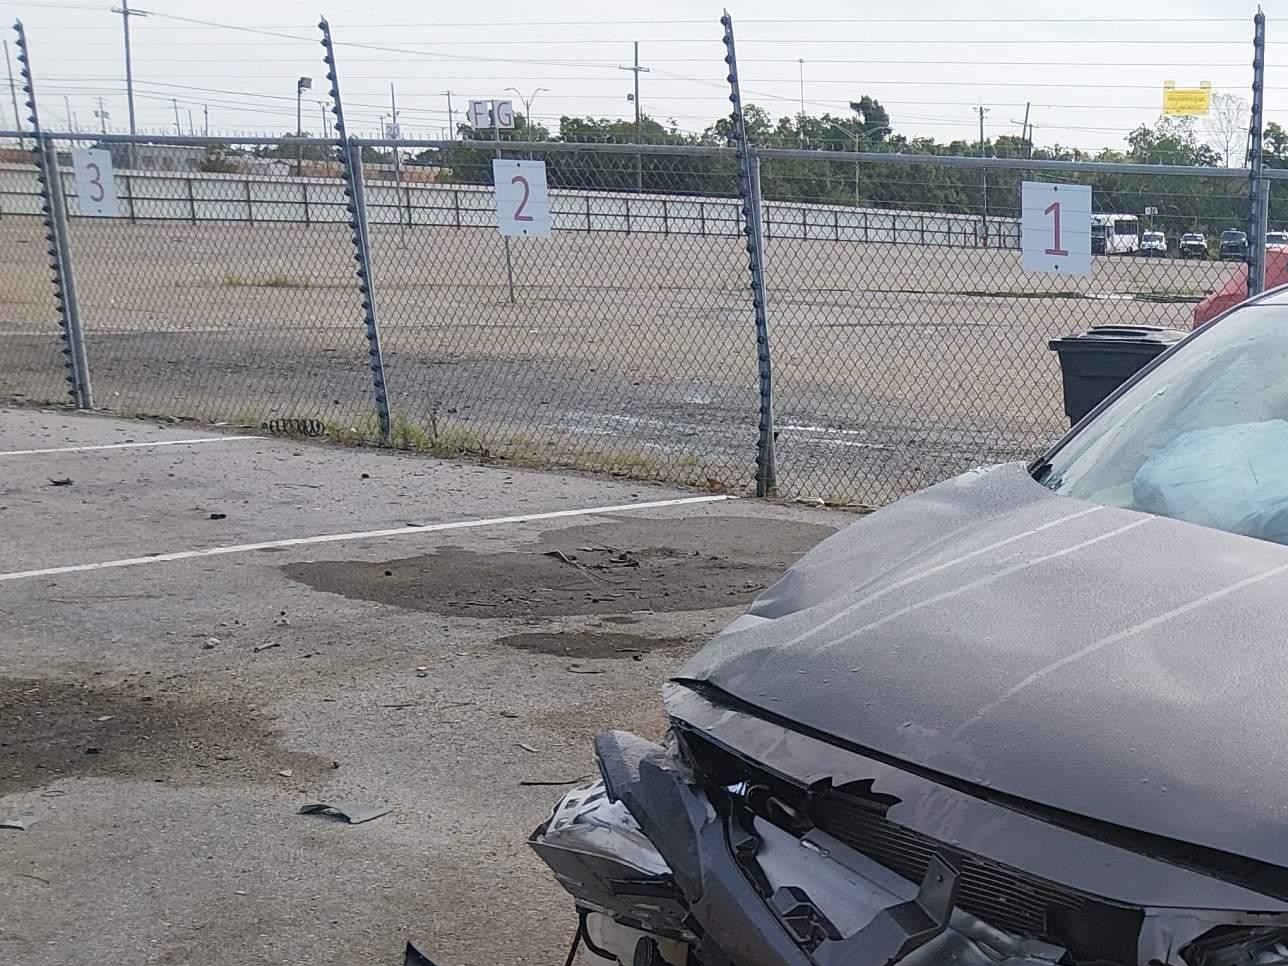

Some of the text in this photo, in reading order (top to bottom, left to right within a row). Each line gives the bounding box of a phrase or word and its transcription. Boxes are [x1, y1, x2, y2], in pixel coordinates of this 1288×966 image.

[473, 101, 483, 126] F
[497, 101, 512, 127] G
[86, 163, 104, 202] 3
[511, 175, 534, 222] 2
[1044, 202, 1068, 256] 1
